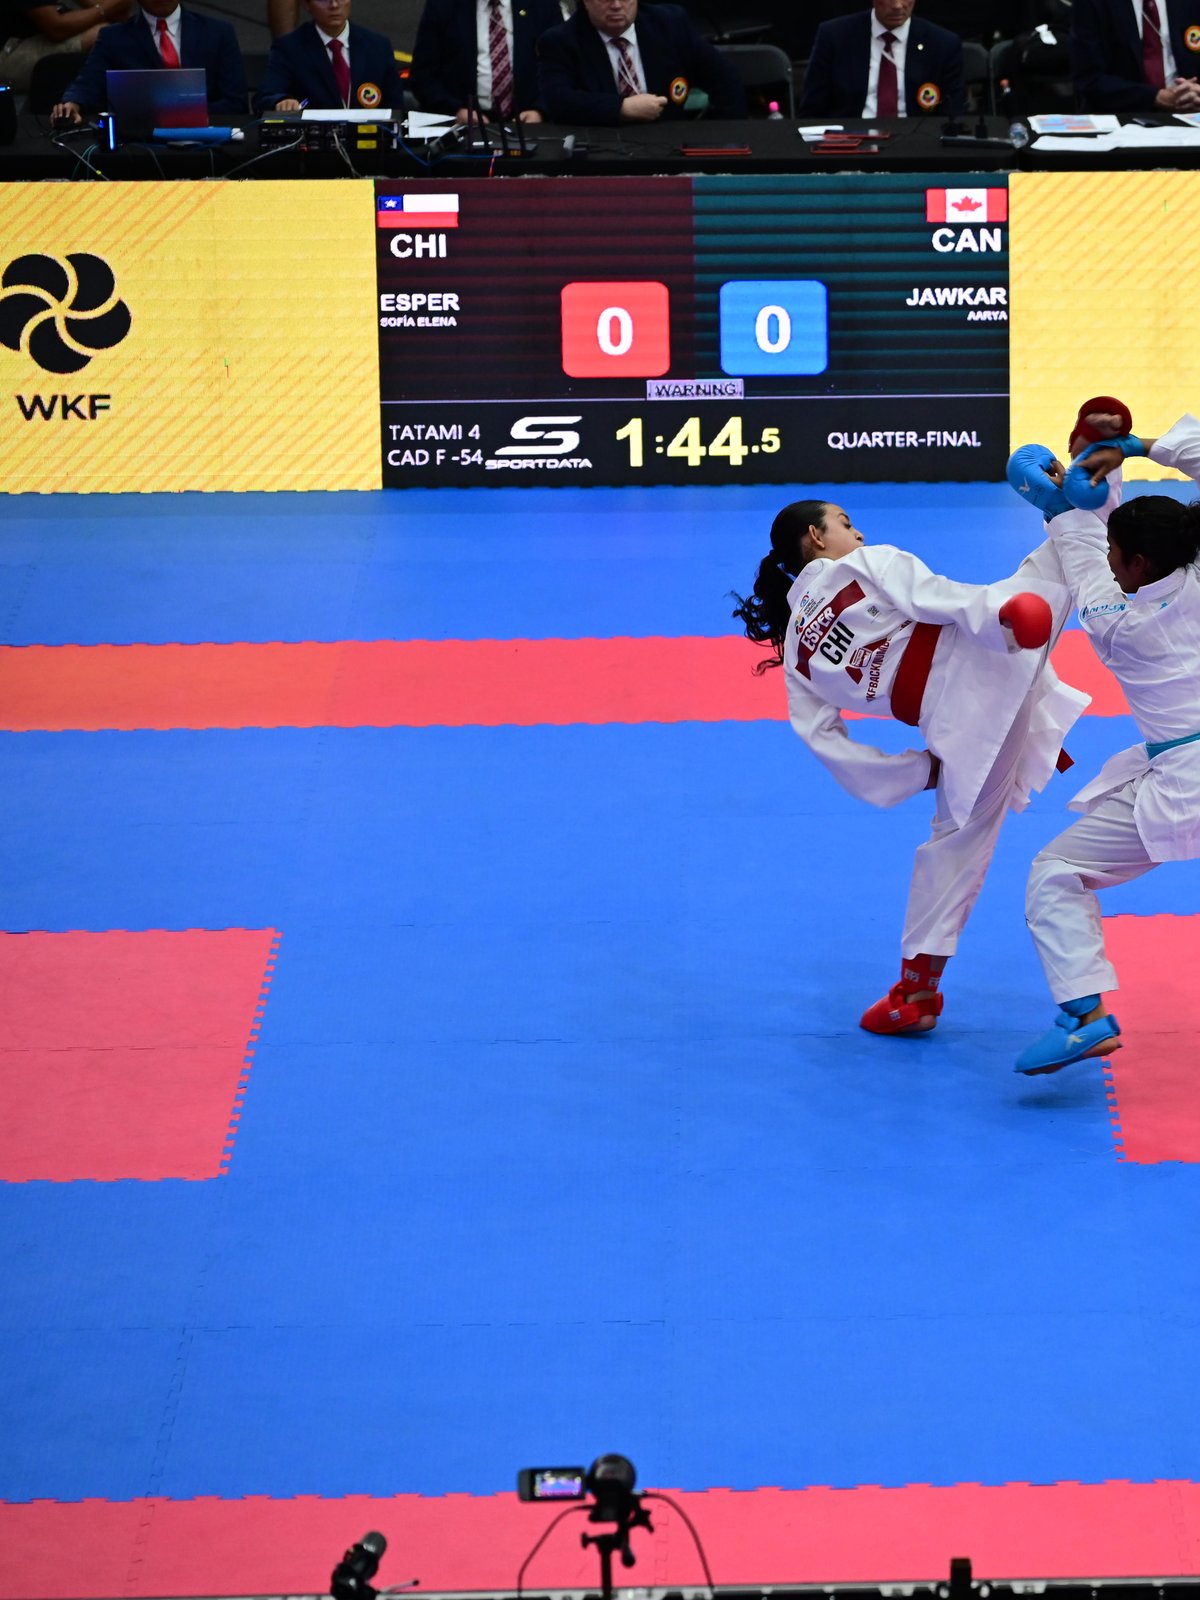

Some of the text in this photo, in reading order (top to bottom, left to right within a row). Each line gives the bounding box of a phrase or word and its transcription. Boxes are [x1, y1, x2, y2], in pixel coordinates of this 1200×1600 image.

[390, 233, 447, 258] CHI
[931, 228, 1001, 253] CAN
[380, 293, 460, 311] ESPER
[906, 287, 1008, 306] JAWKAR
[380, 314, 457, 327] SOFÍA ELENA
[967, 310, 1008, 321] AARYA
[597, 307, 634, 356] 0
[754, 305, 792, 354] 0
[656, 383, 736, 397] WARNING
[15, 394, 112, 421] WKF
[389, 424, 481, 440] TATAMI 4
[827, 430, 982, 450] QUARTER-FINAL
[387, 449, 484, 466] CAD F -54
[484, 458, 593, 470] SPORTDATA
[800, 606, 836, 652] ESPER
[819, 620, 855, 666] CHI
